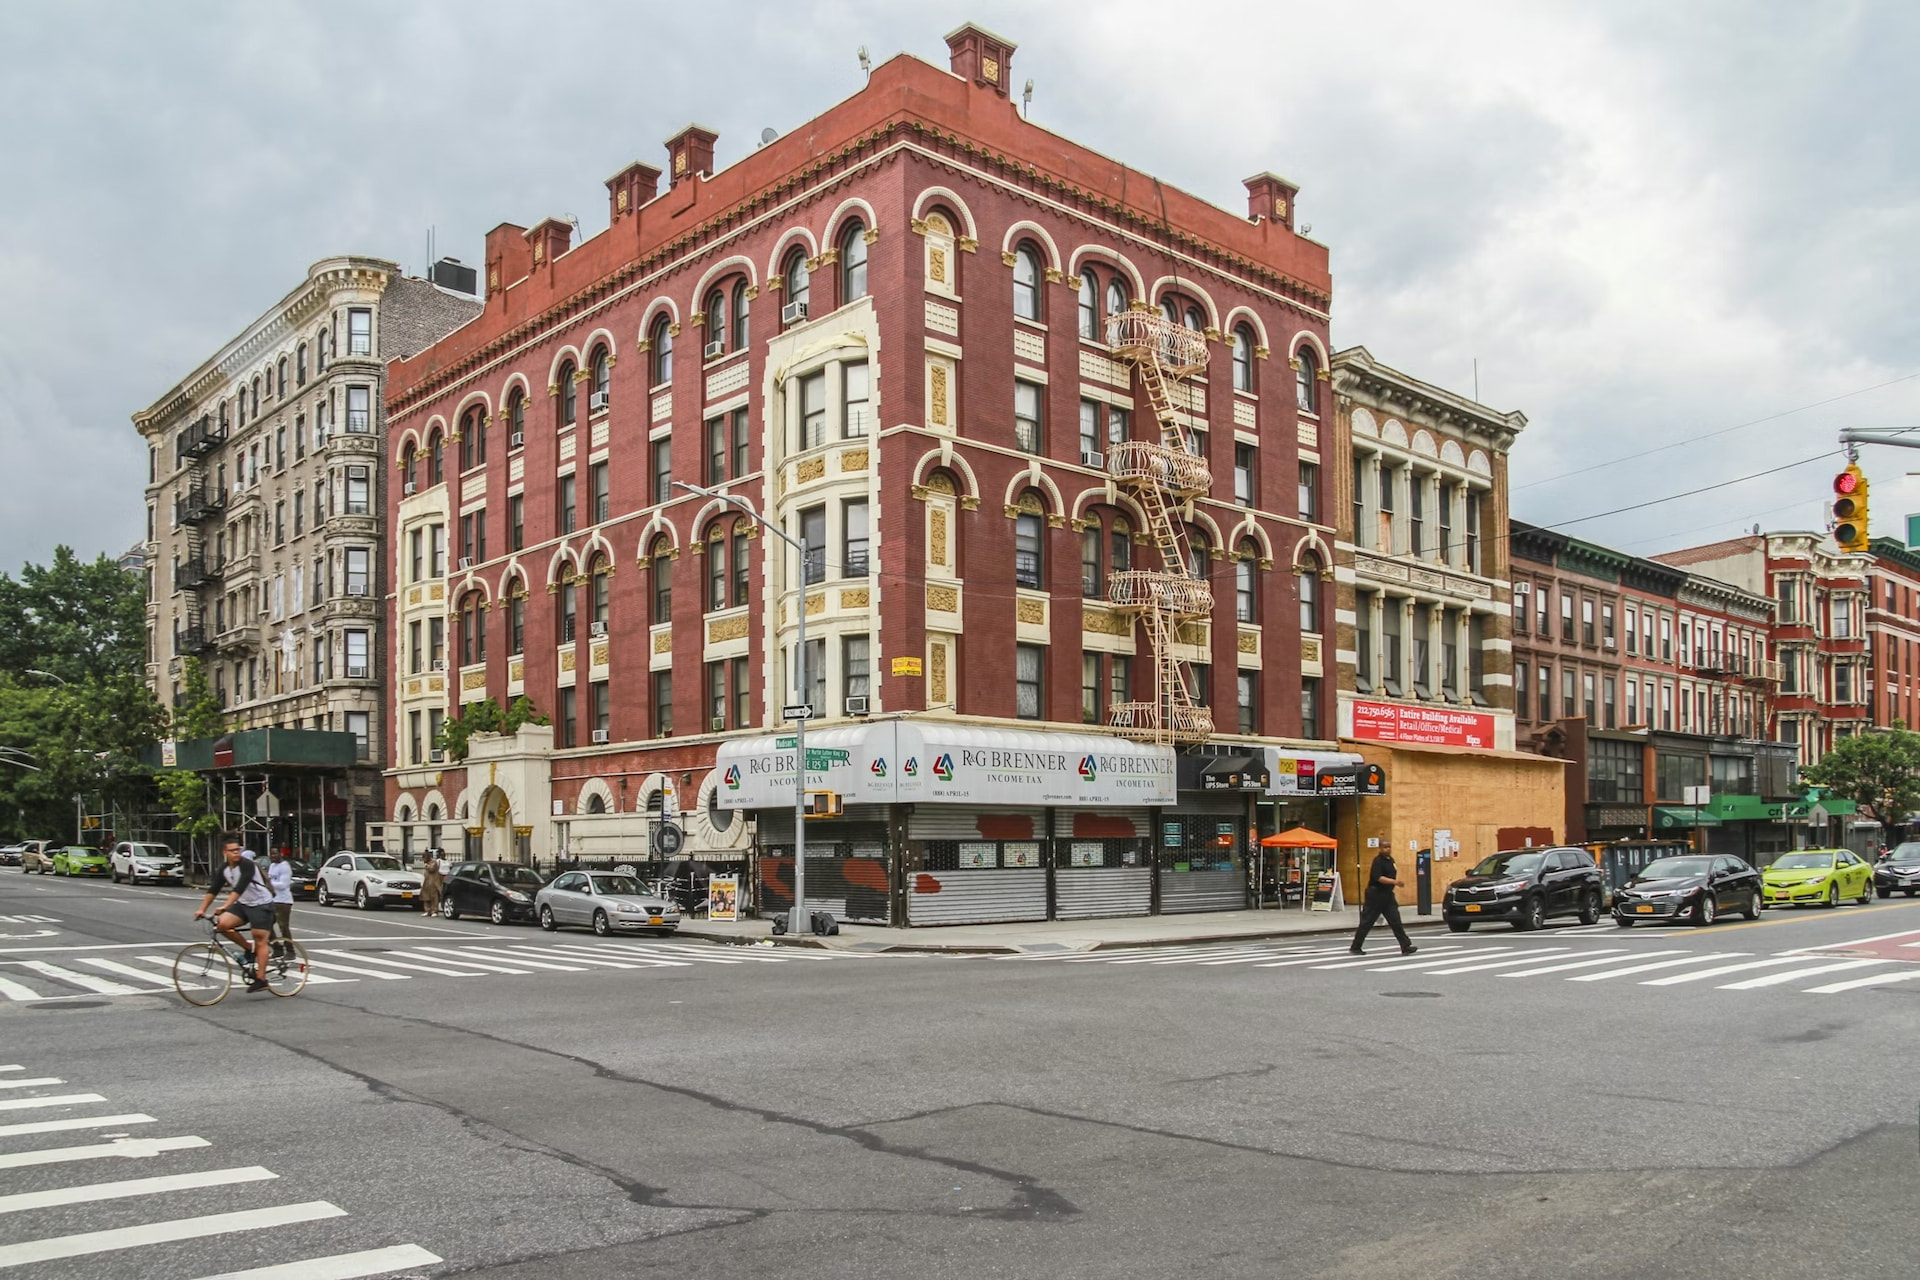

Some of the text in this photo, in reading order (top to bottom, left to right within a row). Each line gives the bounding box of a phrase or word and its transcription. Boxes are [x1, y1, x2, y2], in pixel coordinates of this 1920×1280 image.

[1399, 708, 1478, 725] Entire Building Available
[777, 739, 792, 748] Madison
[822, 749, 833, 757] Luther
[806, 760, 811, 769] E
[811, 760, 821, 769] 125
[962, 750, 1067, 771] R&G BRENNER
[1100, 756, 1117, 773] R&G
[750, 757, 771, 775] R&G
[807, 775, 823, 784] TAX
[987, 774, 1042, 784] INCOME TAX
[1205, 774, 1216, 782] The
[1243, 772, 1251, 780] The
[1333, 775, 1356, 783] boost
[1116, 780, 1155, 788] INCOME TAX
[1250, 780, 1261, 788] Store
